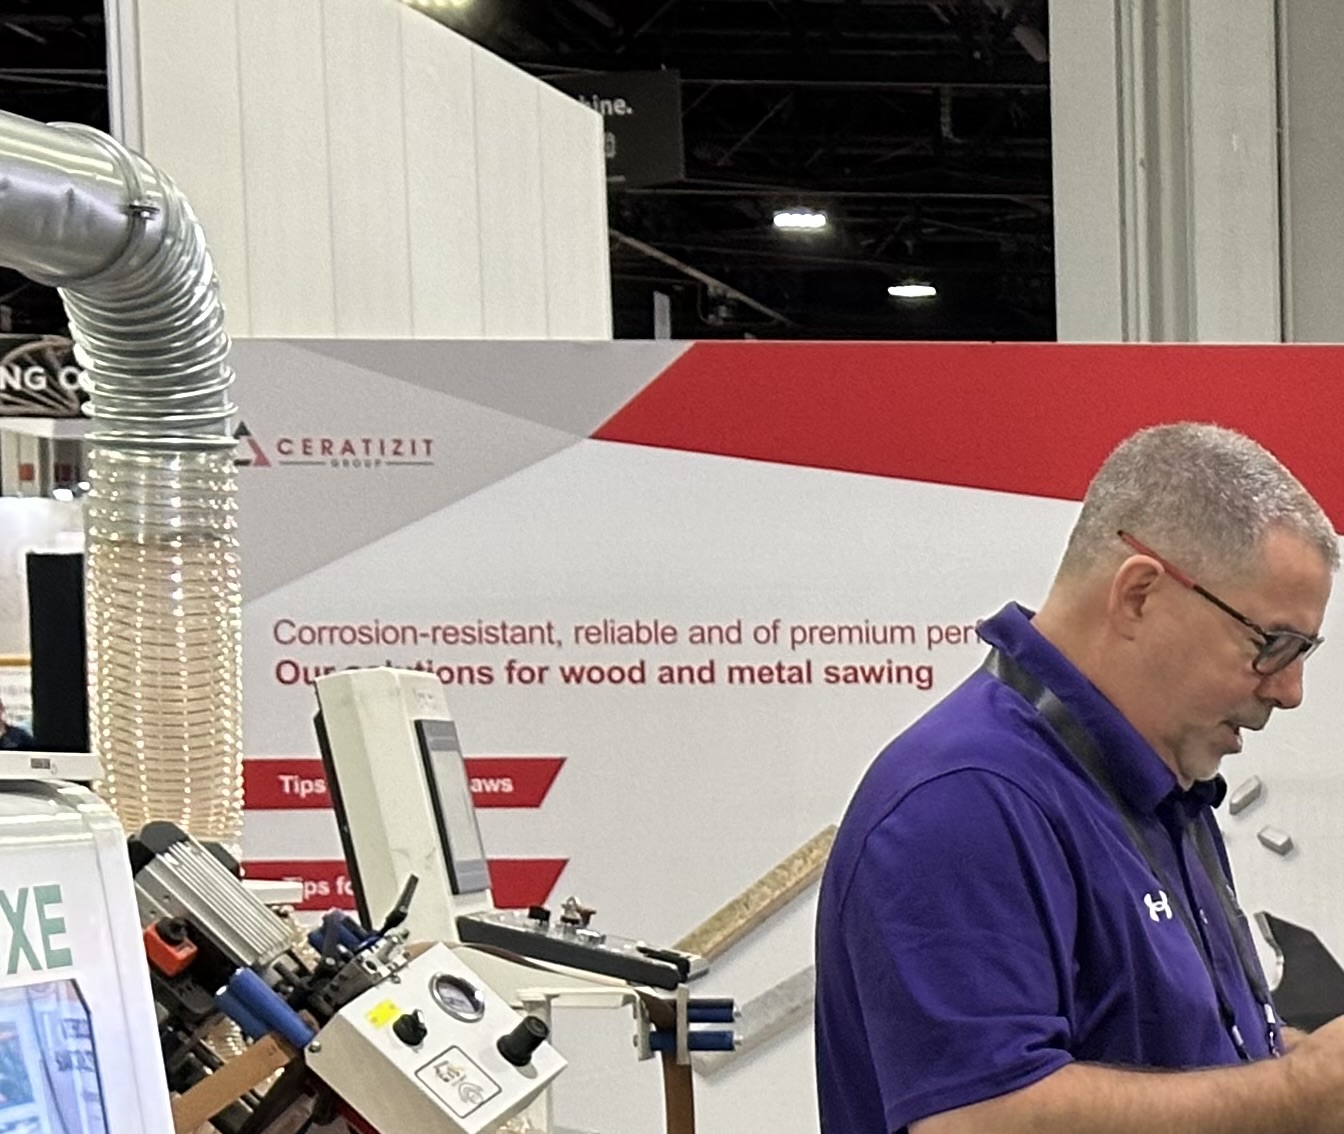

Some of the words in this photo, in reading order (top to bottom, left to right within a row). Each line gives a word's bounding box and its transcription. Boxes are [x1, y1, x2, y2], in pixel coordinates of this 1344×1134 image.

[276, 437, 434, 456] CERATIZIT
[273, 619, 563, 648] Corrosion-resistant,
[573, 619, 678, 645] reliable
[688, 619, 742, 645] and
[753, 619, 781, 645] of
[790, 619, 916, 650] premium
[504, 659, 549, 685] for
[558, 659, 646, 685] wood
[658, 659, 716, 685] and
[727, 659, 813, 685] metal
[823, 659, 934, 691] sawing
[278, 774, 327, 797] Tips
